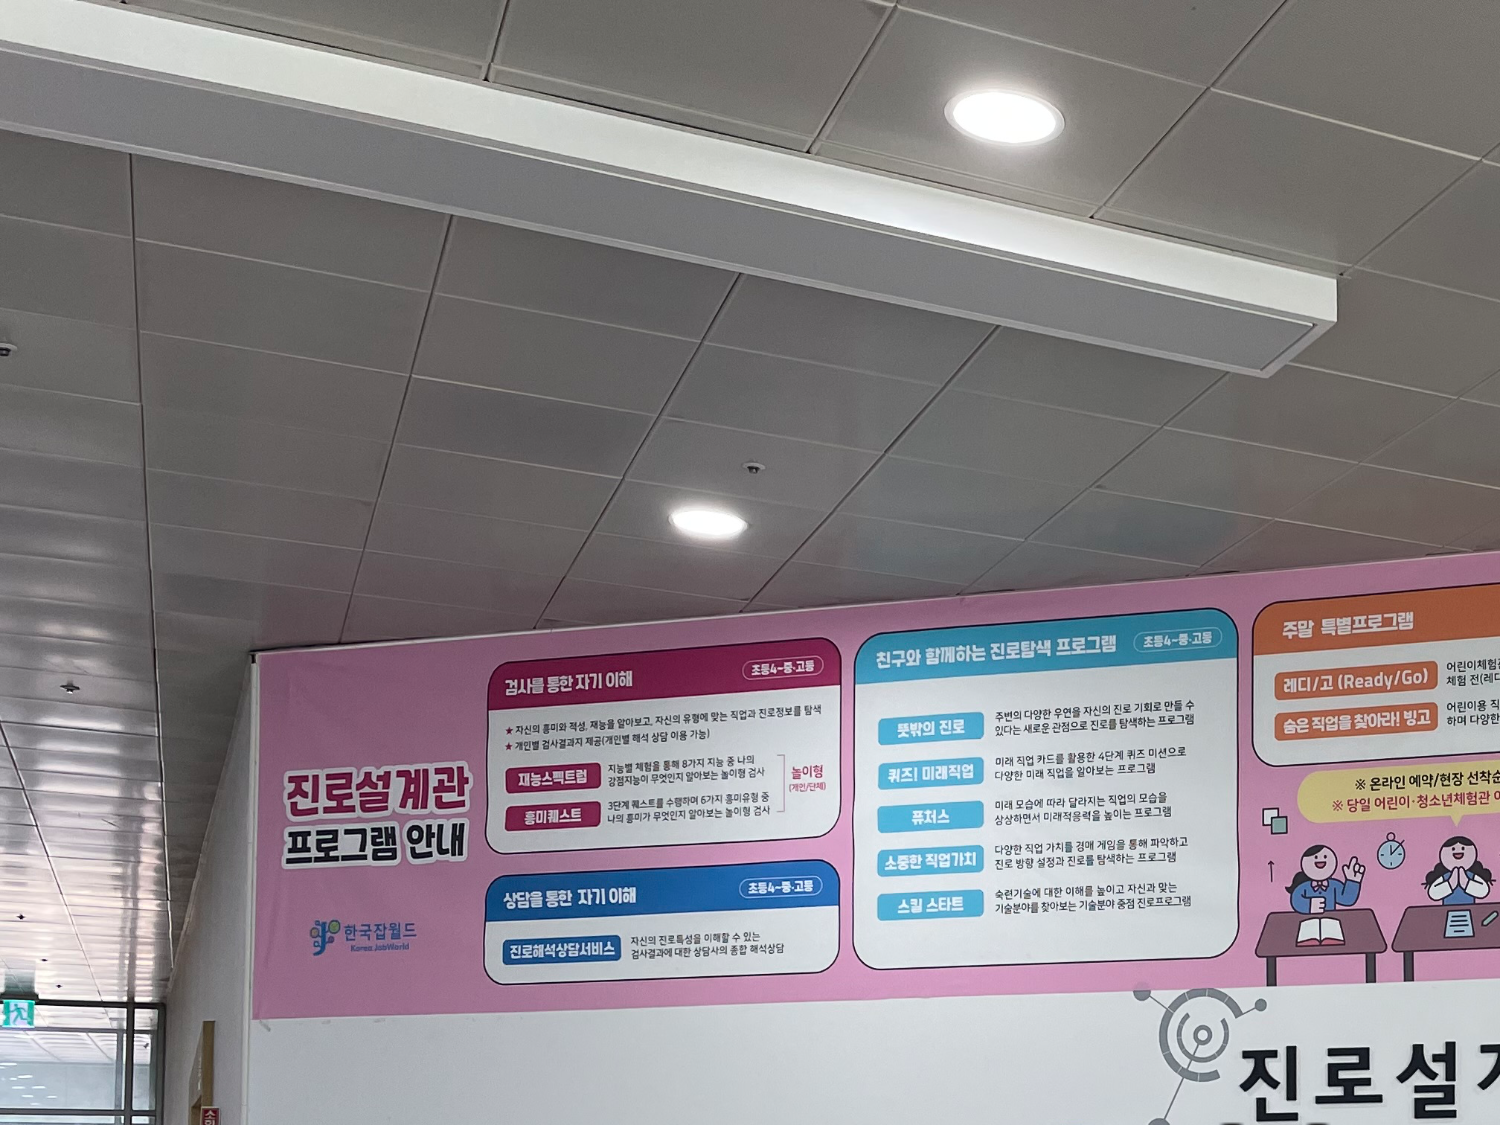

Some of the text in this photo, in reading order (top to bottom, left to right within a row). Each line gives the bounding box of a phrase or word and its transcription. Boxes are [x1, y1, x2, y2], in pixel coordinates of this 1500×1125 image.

[1282, 613, 1413, 639] 주말 특별프로그램
[876, 635, 1115, 669] 친구와 함께하는 진로탐색 프로그램
[505, 671, 632, 696] 검사를 통한 자기 이해
[1284, 673, 1333, 694] 레디/고
[1446, 674, 1465, 686] 체험
[996, 700, 1194, 722] 주변의 다양한 우연을 자신의 진로 기회로 만들 수
[1446, 699, 1486, 712] 어린이용
[515, 723, 539, 736] 자신의
[542, 721, 566, 734] 흥미와
[590, 718, 614, 731] 재능을
[655, 714, 680, 727] 자신의
[683, 712, 707, 725] 유형에
[710, 711, 727, 723] 맞는
[731, 709, 755, 722] 직업과
[759, 706, 800, 720] 진로정보를
[804, 704, 820, 717] 탐색
[897, 718, 964, 738] 뜻밖의 진로
[995, 714, 1193, 736] 있다는 새로운 관점으로 진로를 탐색하는 프로그램
[1283, 709, 1430, 734] 숨은 직업을 찾아라! 빙고
[1447, 714, 1466, 726] 하며
[1470, 712, 1499, 725] 다양한
[515, 739, 539, 751] 개인별
[542, 736, 582, 750] 검사결과지
[632, 732, 648, 744] 해석
[651, 731, 667, 743] 상담
[670, 729, 686, 742] 이용
[690, 728, 709, 740] 가능)
[518, 770, 586, 786] 재능스펙트럼
[792, 765, 822, 779] 놀이형
[888, 764, 973, 782] 퀴즈! 미래직업
[286, 765, 471, 816] 진로설계관
[1370, 775, 1405, 793] 온라인
[1409, 772, 1463, 790] 예약/현장
[1347, 796, 1370, 812] 당일
[524, 808, 581, 824] 흥미퀘스트
[912, 810, 949, 826] 퓨처스
[286, 822, 465, 864] 프로그램 안내
[884, 851, 976, 870] 소중한 직업가치
[503, 887, 636, 910] 상담을 통한 자기 이해
[897, 897, 963, 914] 스킬 스타트
[344, 922, 417, 941] 한국잡월드
[351, 944, 373, 952] Korea
[510, 942, 614, 959] 진로해석상담서비스
